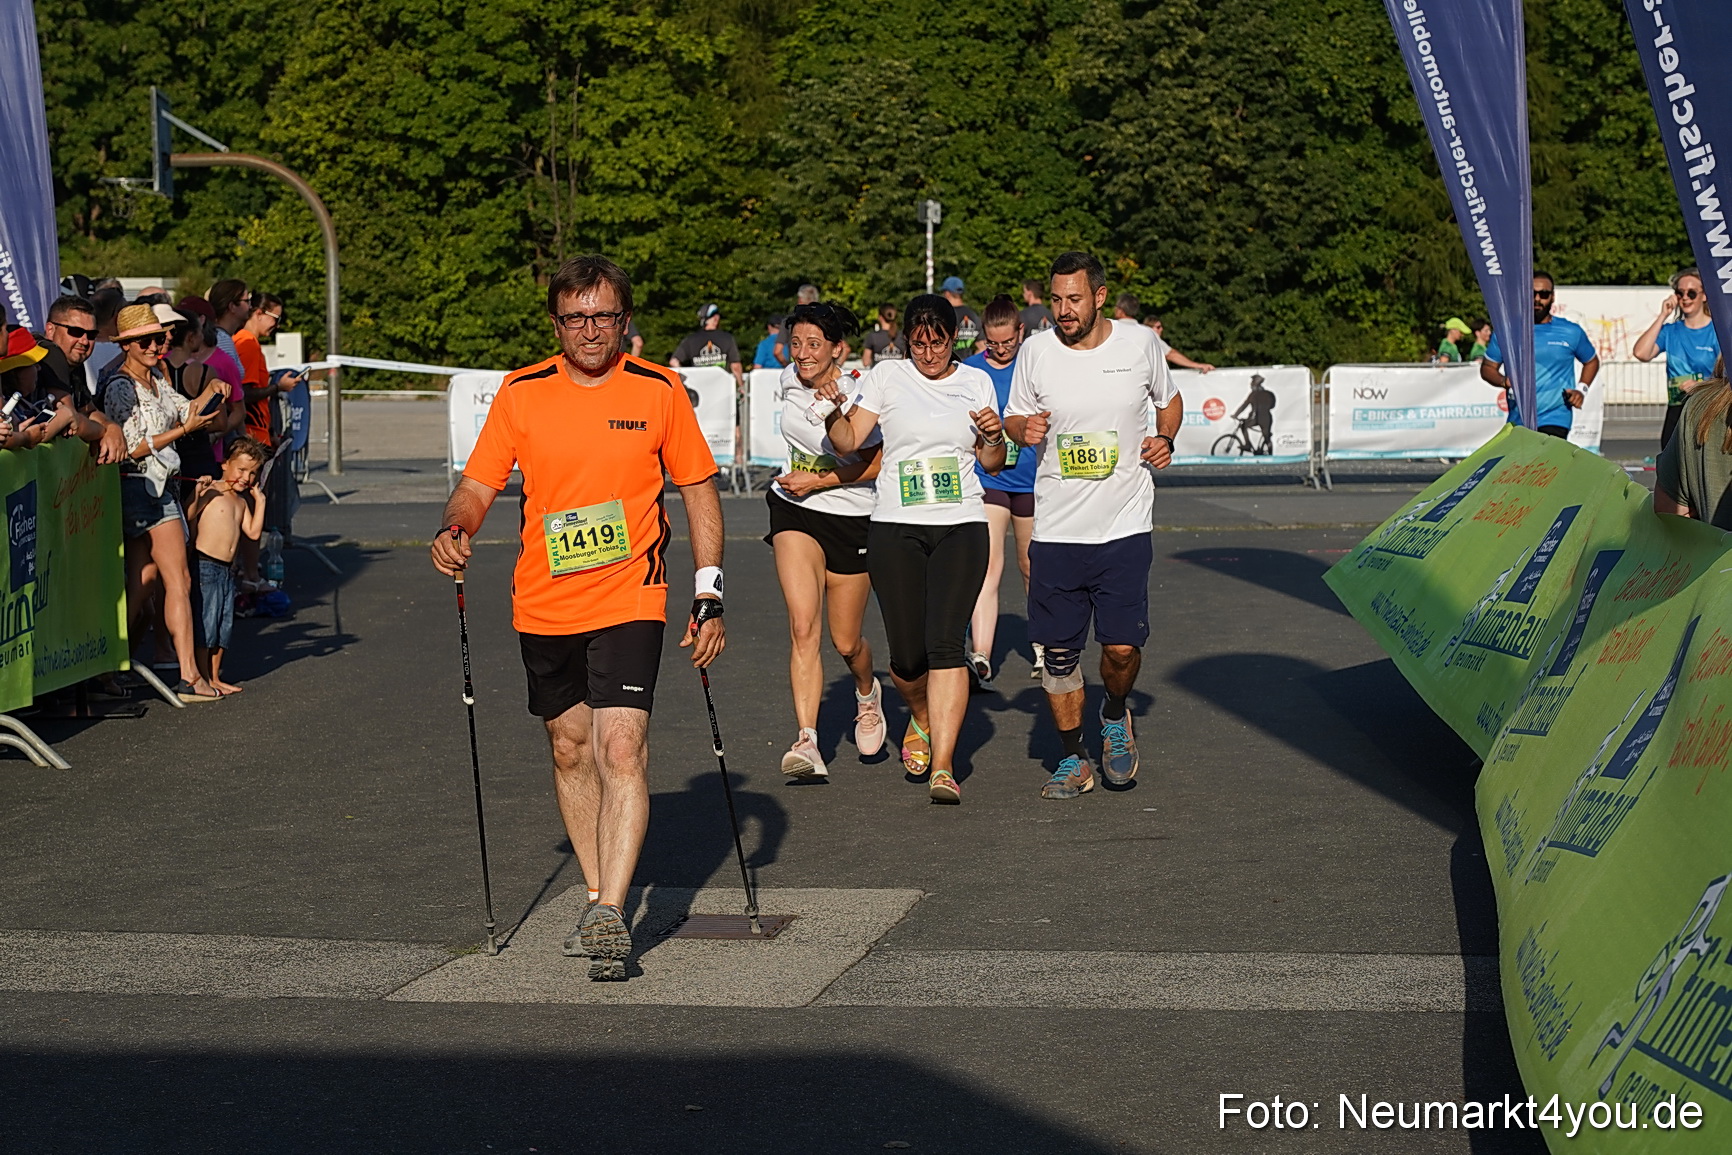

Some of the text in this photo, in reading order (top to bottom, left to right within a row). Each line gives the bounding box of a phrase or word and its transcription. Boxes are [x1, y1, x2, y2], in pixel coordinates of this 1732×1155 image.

[473, 392, 494, 405] NO
[1353, 387, 1388, 400] NOW
[1354, 405, 1499, 421] E-BIKES & FAHRRÄDER
[608, 420, 647, 431] THULE
[1061, 451, 1069, 473] WALK
[1068, 447, 1107, 465] 1881
[902, 481, 910, 497] RUN
[935, 488, 954, 496] Evelyn
[951, 474, 960, 496] 2022
[559, 524, 615, 552] 1419
[616, 524, 627, 552] 2022
[550, 537, 561, 567] WALK
[559, 549, 597, 561] Moosburger
[598, 544, 619, 554] Tobias
[1452, 649, 1488, 672] neumarkt
[622, 684, 644, 692] benger
